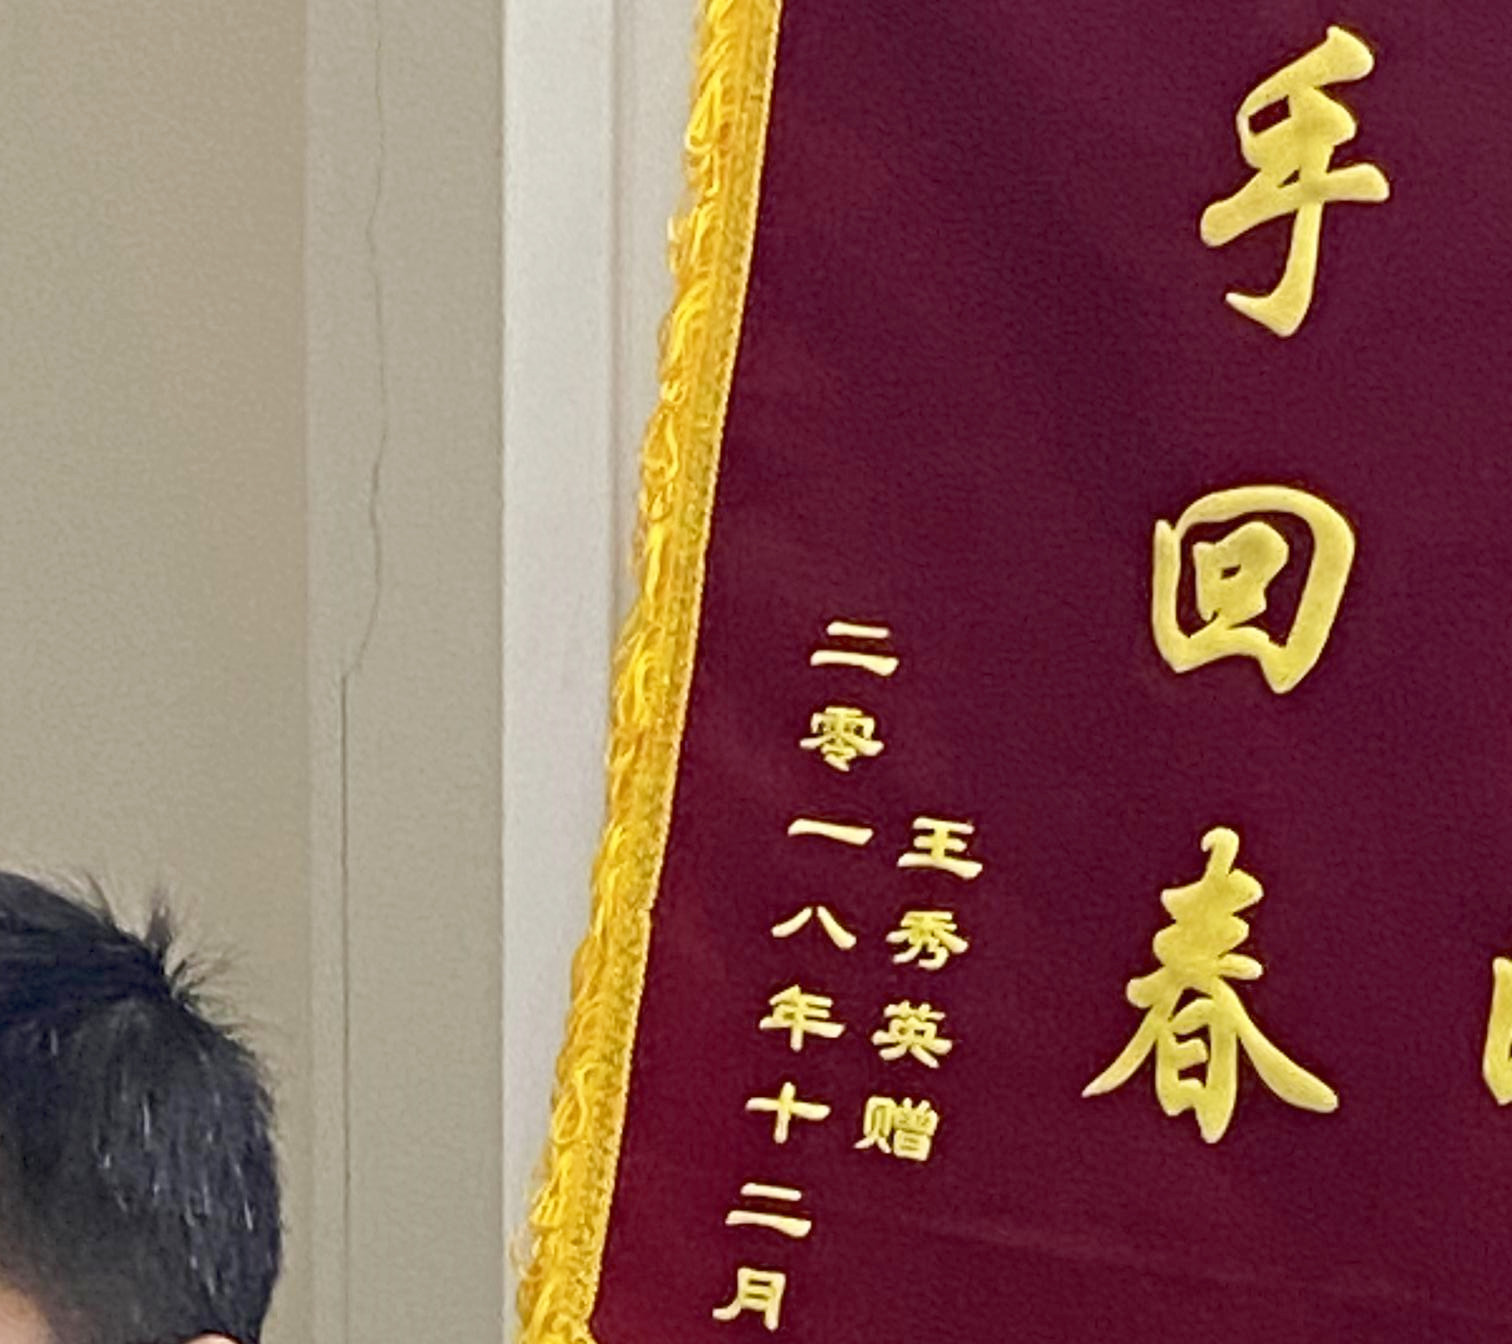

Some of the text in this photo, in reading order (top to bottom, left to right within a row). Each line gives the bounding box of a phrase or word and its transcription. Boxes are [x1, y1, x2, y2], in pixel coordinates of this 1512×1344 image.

[1082, 26, 1390, 1144] 手回春
[712, 620, 899, 1332] 二零一八年十二月
[854, 816, 984, 1163] 王秀英赠
